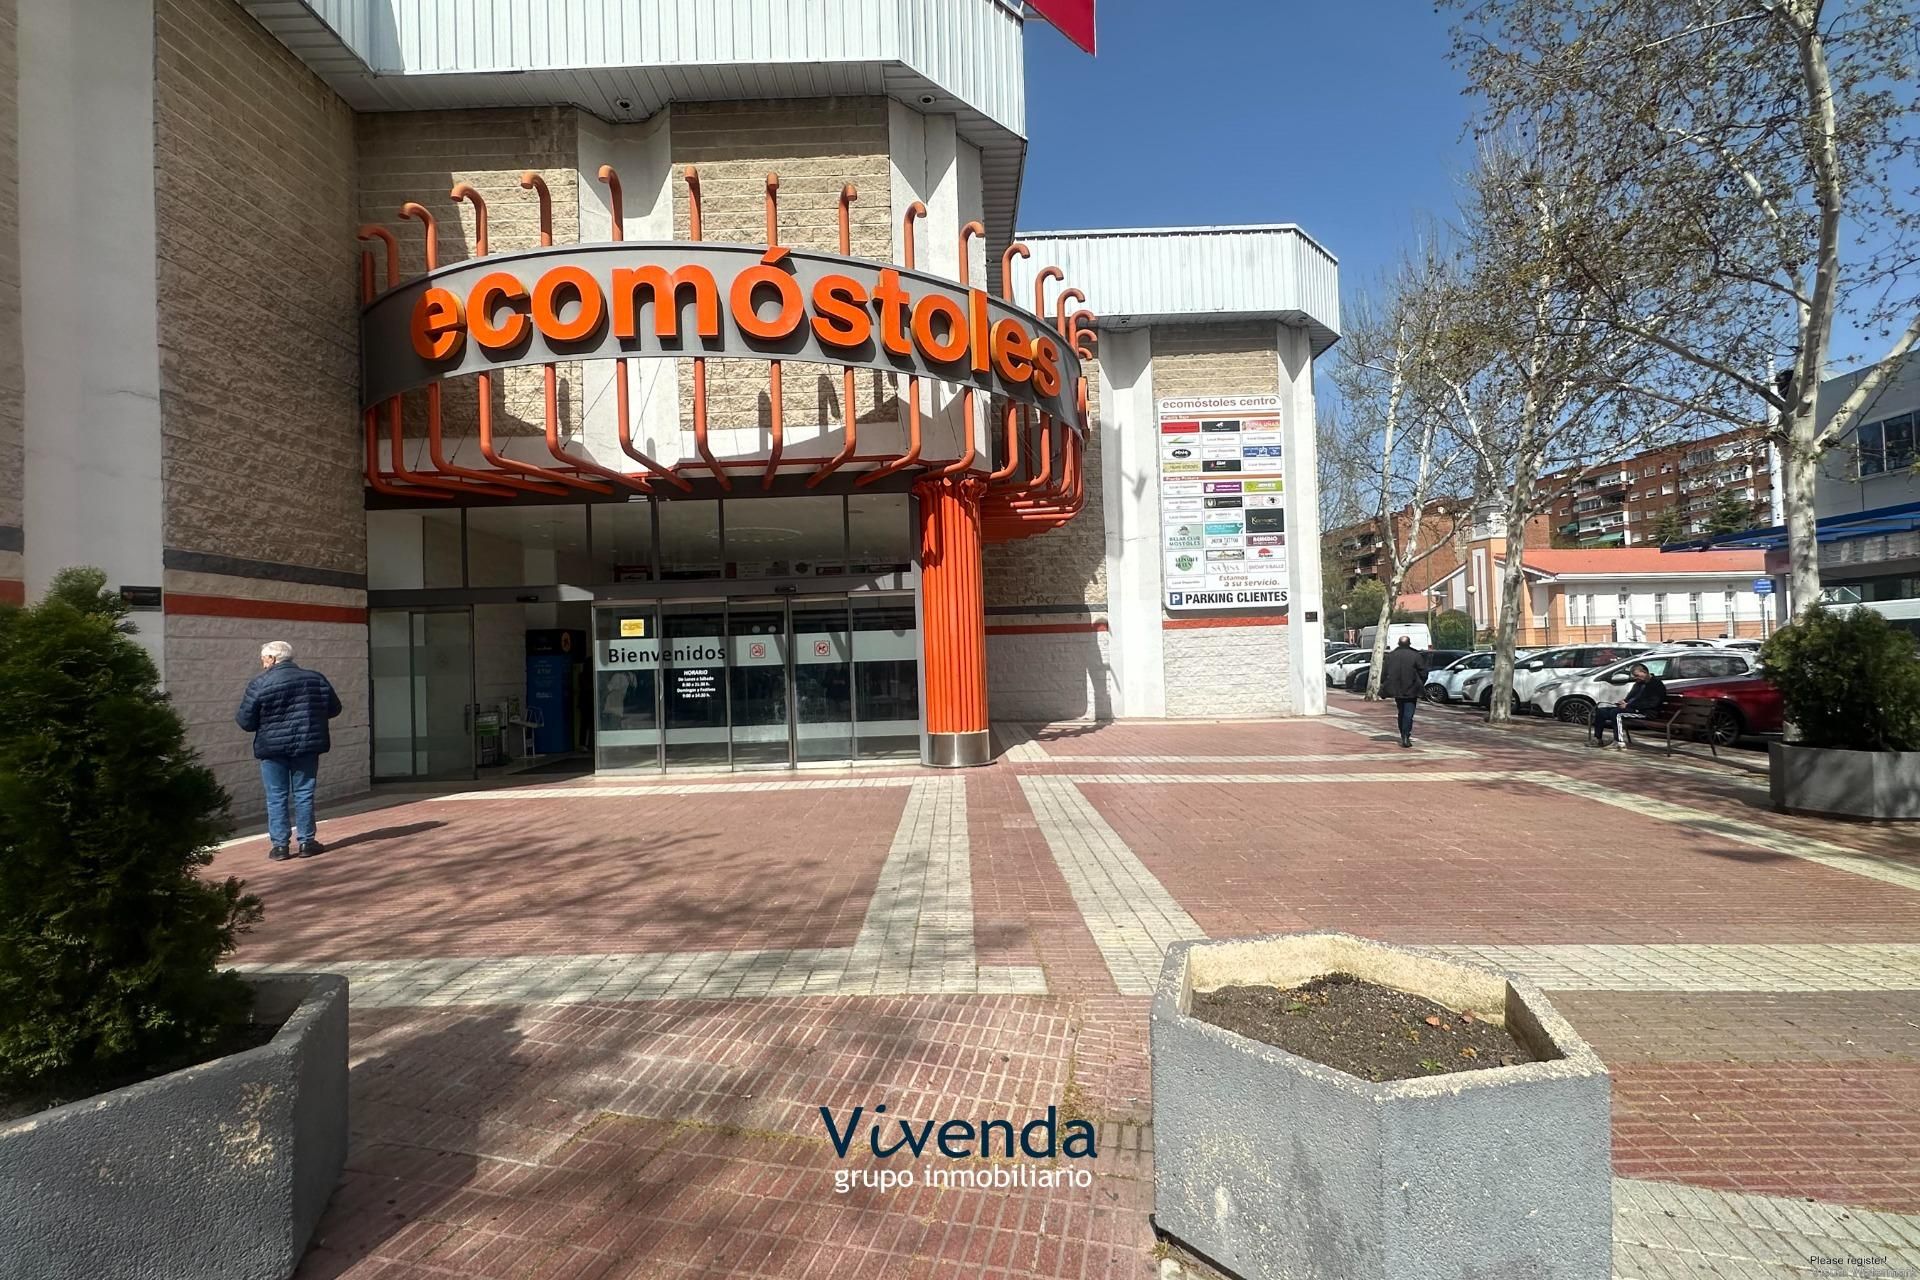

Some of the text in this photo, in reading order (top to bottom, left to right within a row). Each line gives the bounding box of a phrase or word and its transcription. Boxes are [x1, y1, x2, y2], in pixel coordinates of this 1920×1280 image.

[411, 245, 1061, 397] ecomóstoles
[1163, 397, 1276, 408] ecomóstoles centro
[1186, 592, 1233, 604] PARKING
[1237, 591, 1288, 603] CLIENTES
[608, 645, 726, 663] Bienvenidos
